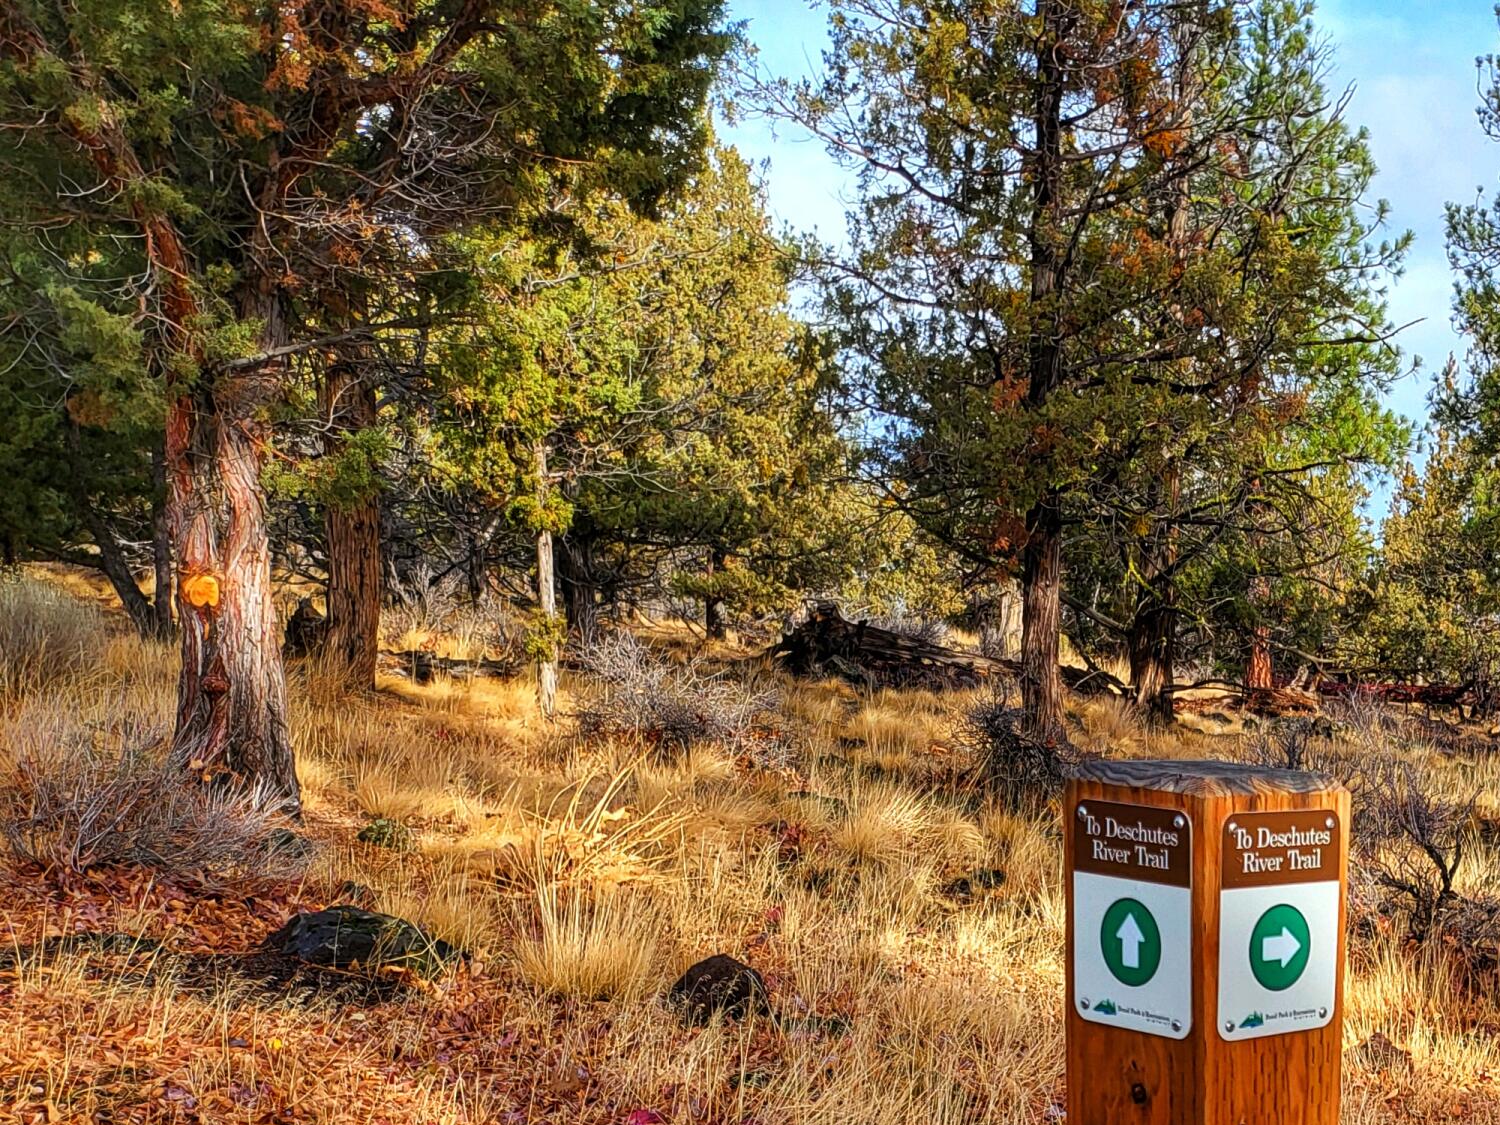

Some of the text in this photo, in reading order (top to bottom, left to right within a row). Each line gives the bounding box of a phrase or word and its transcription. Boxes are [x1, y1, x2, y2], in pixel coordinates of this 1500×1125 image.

[1085, 815, 1179, 847] To Deschutes
[1234, 826, 1331, 850] To Deschutes
[1092, 839, 1170, 870] River Trail
[1242, 848, 1322, 874] River Trail
